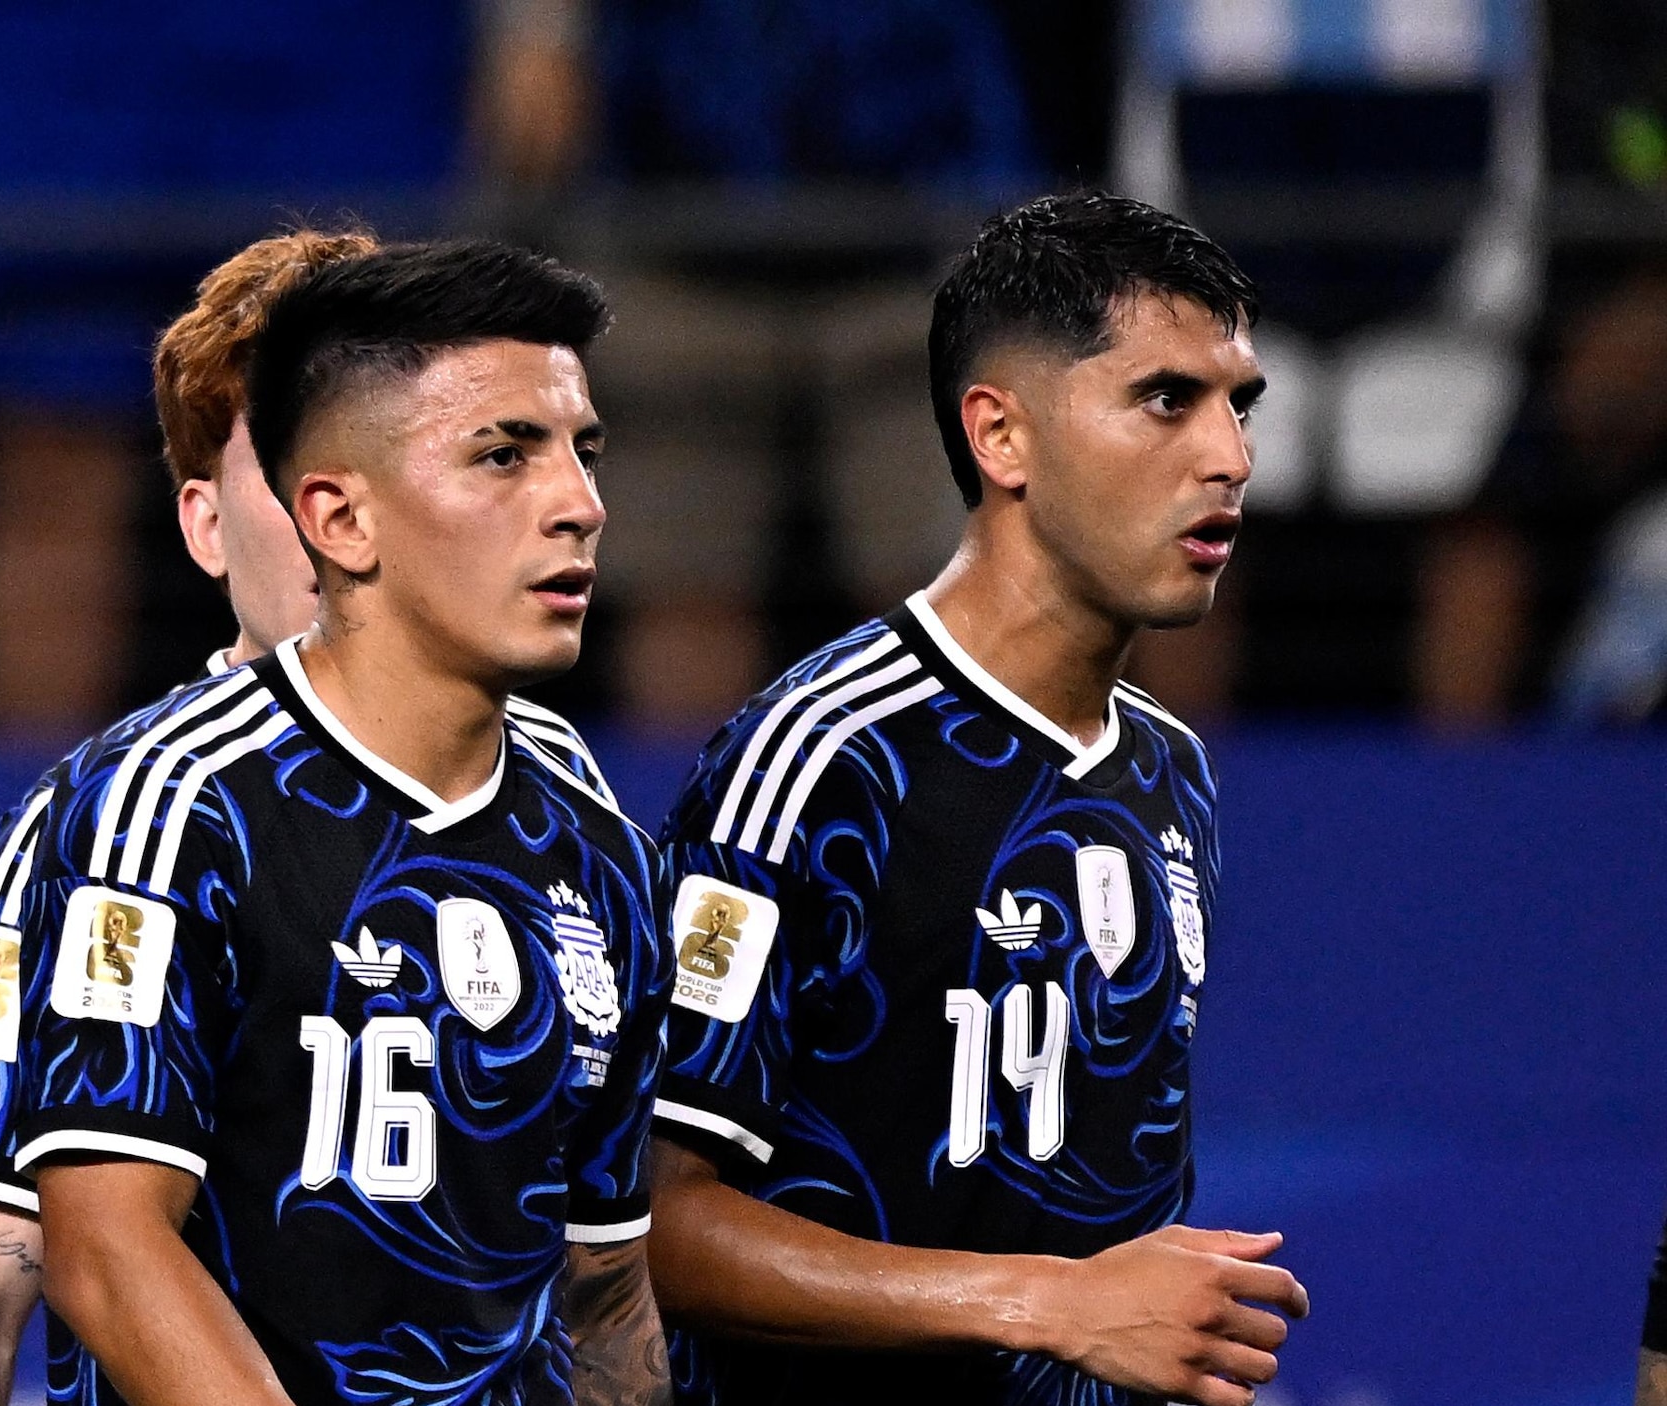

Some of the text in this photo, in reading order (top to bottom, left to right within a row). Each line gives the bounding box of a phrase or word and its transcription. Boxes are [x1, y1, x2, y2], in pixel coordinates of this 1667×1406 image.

[1099, 928, 1117, 944] FIFA
[573, 947, 607, 1001] AFA
[692, 956, 716, 973] FIFA
[467, 980, 501, 995] FIFA
[677, 974, 723, 993] ORLD CUP
[945, 981, 1070, 1168] 14
[300, 1016, 437, 1202] 16
